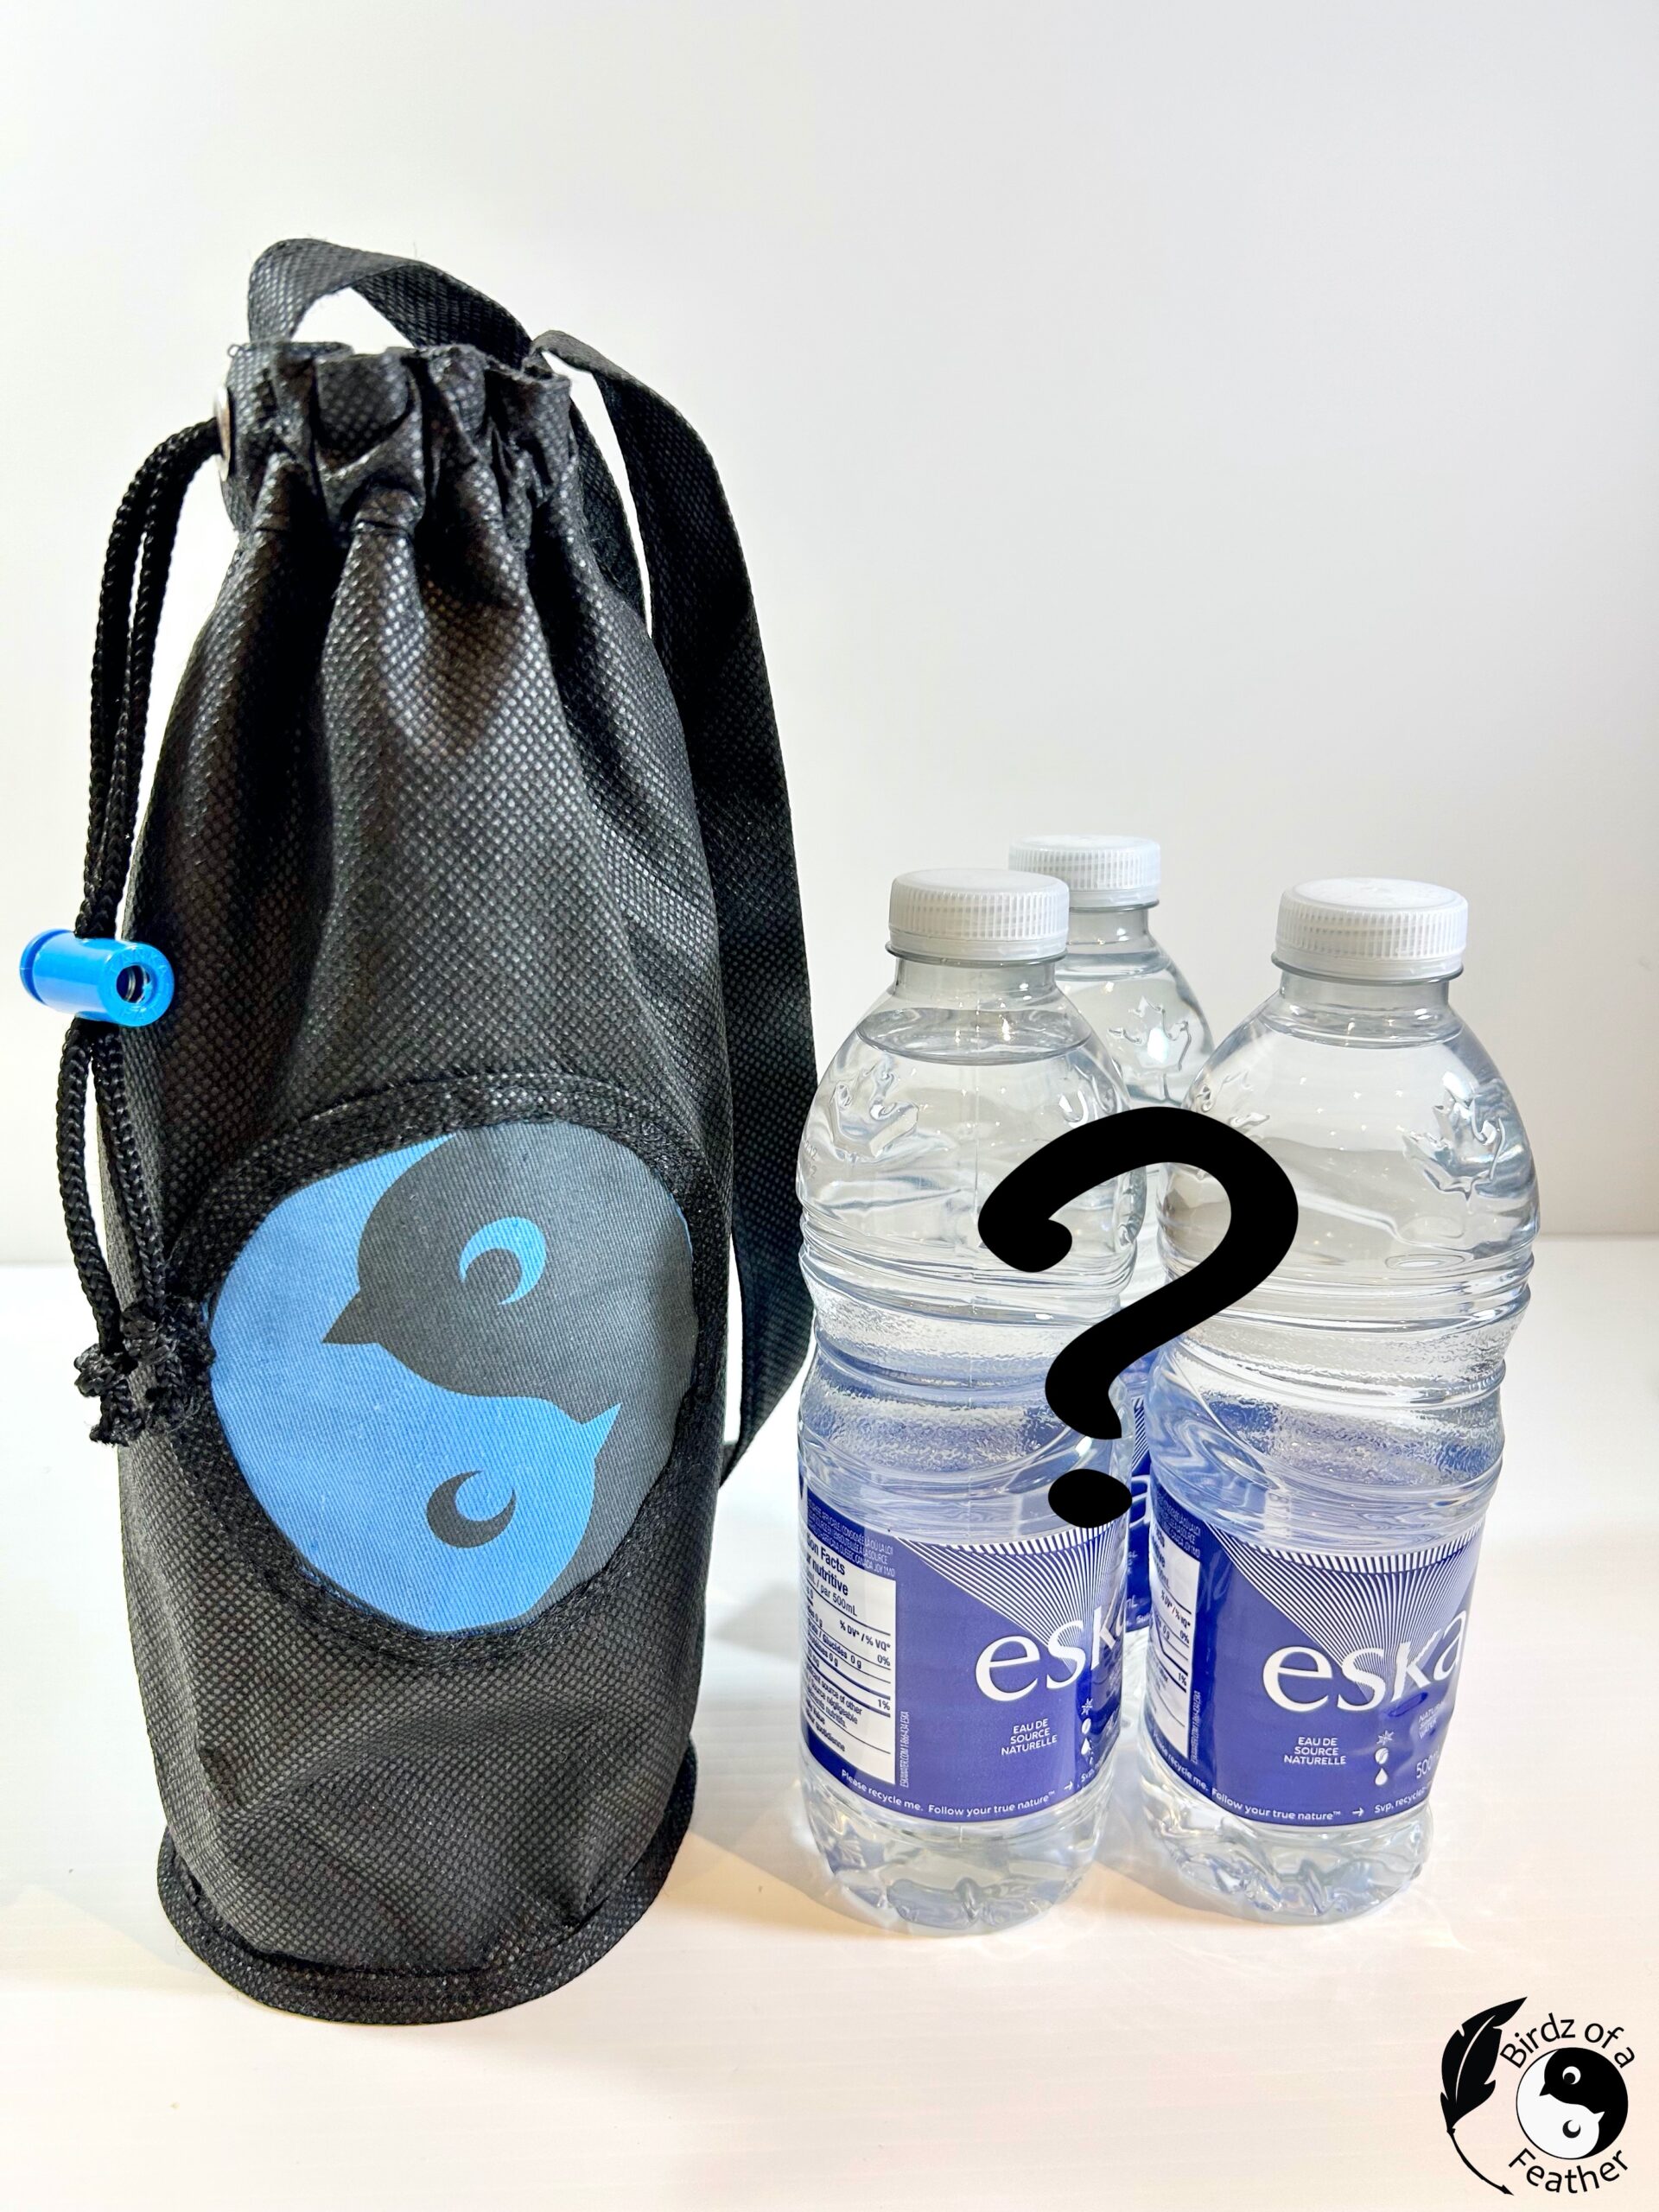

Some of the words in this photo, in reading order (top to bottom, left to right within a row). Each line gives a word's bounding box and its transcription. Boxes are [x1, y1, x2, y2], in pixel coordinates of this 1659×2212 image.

[821, 1546, 846, 1575] Facts
[812, 1559, 849, 1596] nutritive
[820, 1585, 831, 1598] par
[832, 1593, 858, 1617] 500mL
[877, 1654, 891, 1667] 0%
[1262, 1610, 1467, 1713] eska
[877, 1699, 891, 1711] 1%
[1010, 1727, 1051, 1745] SOURCE
[1013, 1721, 1034, 1735] EAU
[1035, 1718, 1049, 1729] DE
[1001, 1734, 1058, 1756] NATURELLE
[1294, 1746, 1339, 1756] SOURCE
[1298, 1737, 1320, 1746] EAU
[1322, 1737, 1338, 1746] DE
[1284, 1754, 1347, 1765] NATURELLE
[842, 1769, 868, 1792] Please
[868, 1787, 902, 1806] recycle
[904, 1800, 924, 1812] me.
[928, 1804, 964, 1815] Follow
[966, 1806, 992, 1817] your
[994, 1803, 1016, 1814] true
[1167, 1753, 1192, 1780] recycle
[1211, 1787, 1243, 1810] Follow
[1245, 1804, 1271, 1817] your
[1273, 1809, 1295, 1820] true
